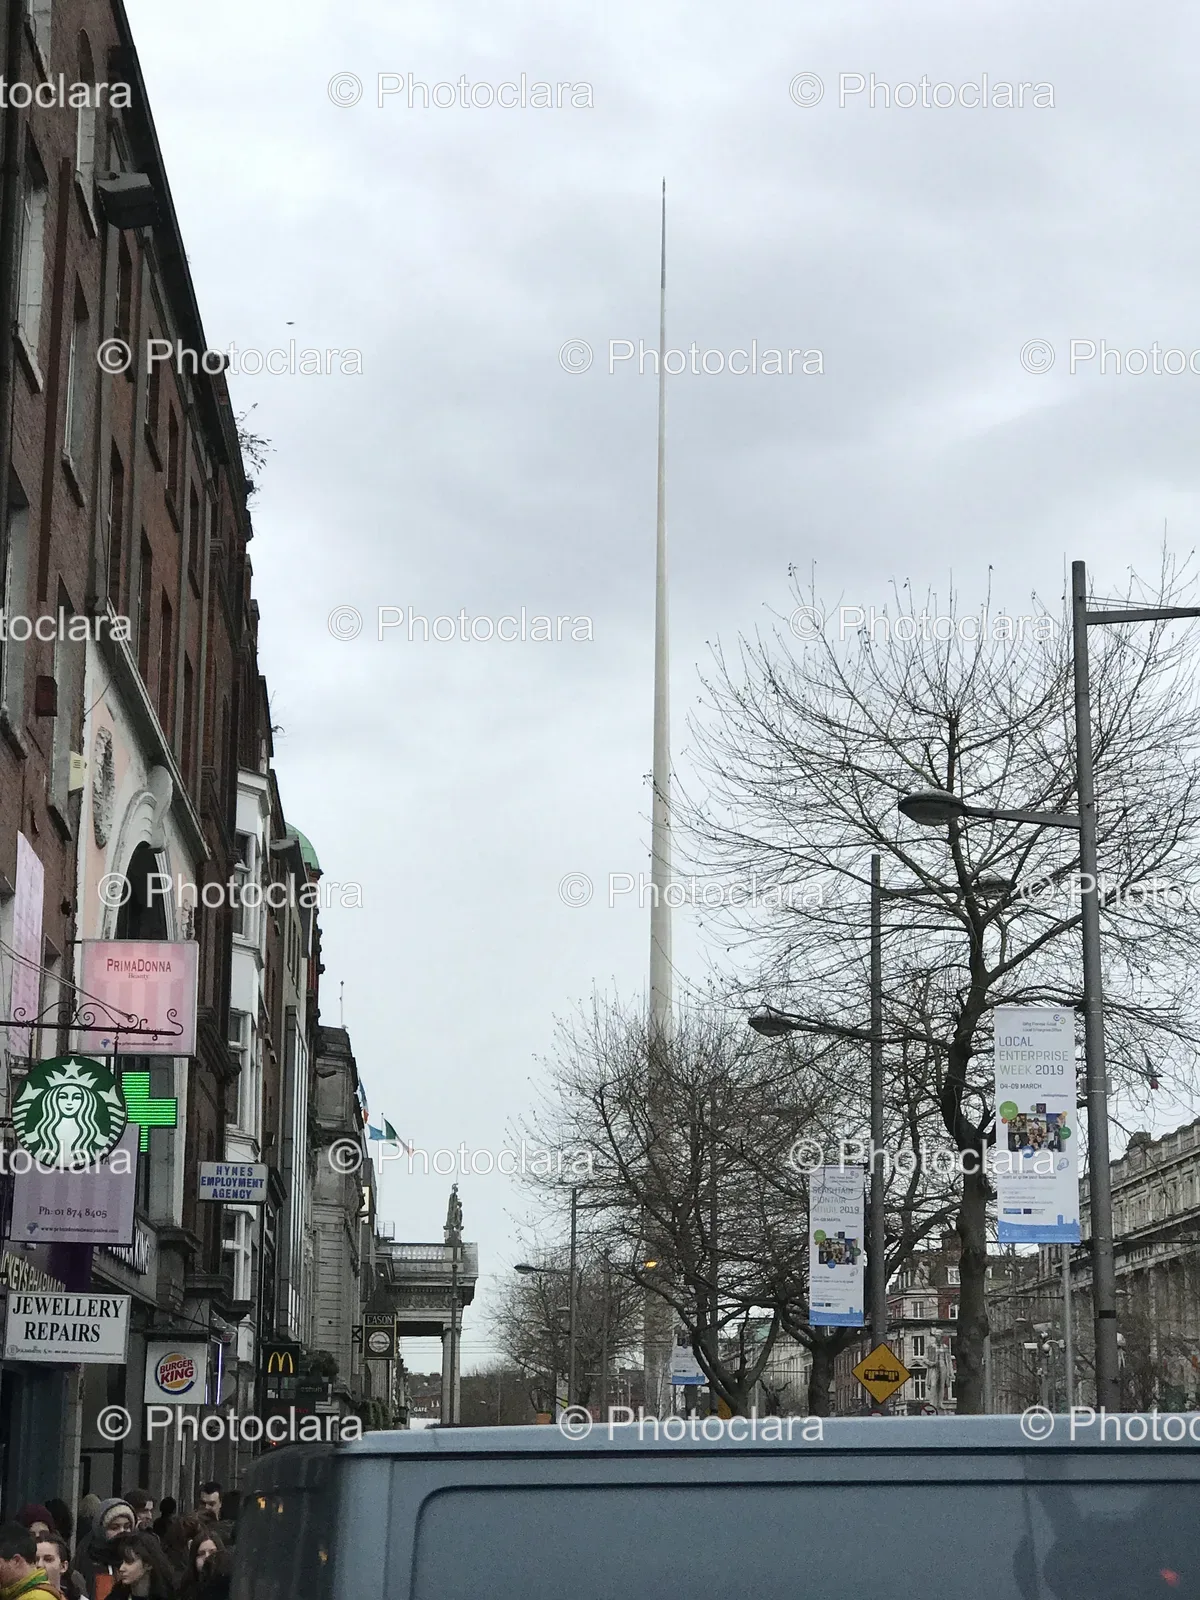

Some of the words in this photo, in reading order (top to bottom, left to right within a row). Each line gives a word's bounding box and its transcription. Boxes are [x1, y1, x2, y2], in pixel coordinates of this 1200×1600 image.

[999, 1036, 1034, 1047] LOCAL
[999, 1050, 1069, 1062] ENTERPRISE
[1000, 1065, 1033, 1076] WEEK
[1035, 1064, 1065, 1076] 2019
[216, 1165, 253, 1177] HYNES
[200, 1176, 265, 1189] EMPLOYMENT
[212, 1188, 252, 1200] AGENCY
[38, 1206, 53, 1216] Ph:
[66, 1207, 82, 1218] 874
[84, 1208, 108, 1219] 8405
[839, 1205, 860, 1215] 2019
[12, 1296, 124, 1318] JEWELLERY
[367, 1315, 394, 1325] EASON
[24, 1321, 101, 1343] REPAIRS
[160, 1359, 193, 1374] BURGER
[160, 1366, 194, 1385] KING
